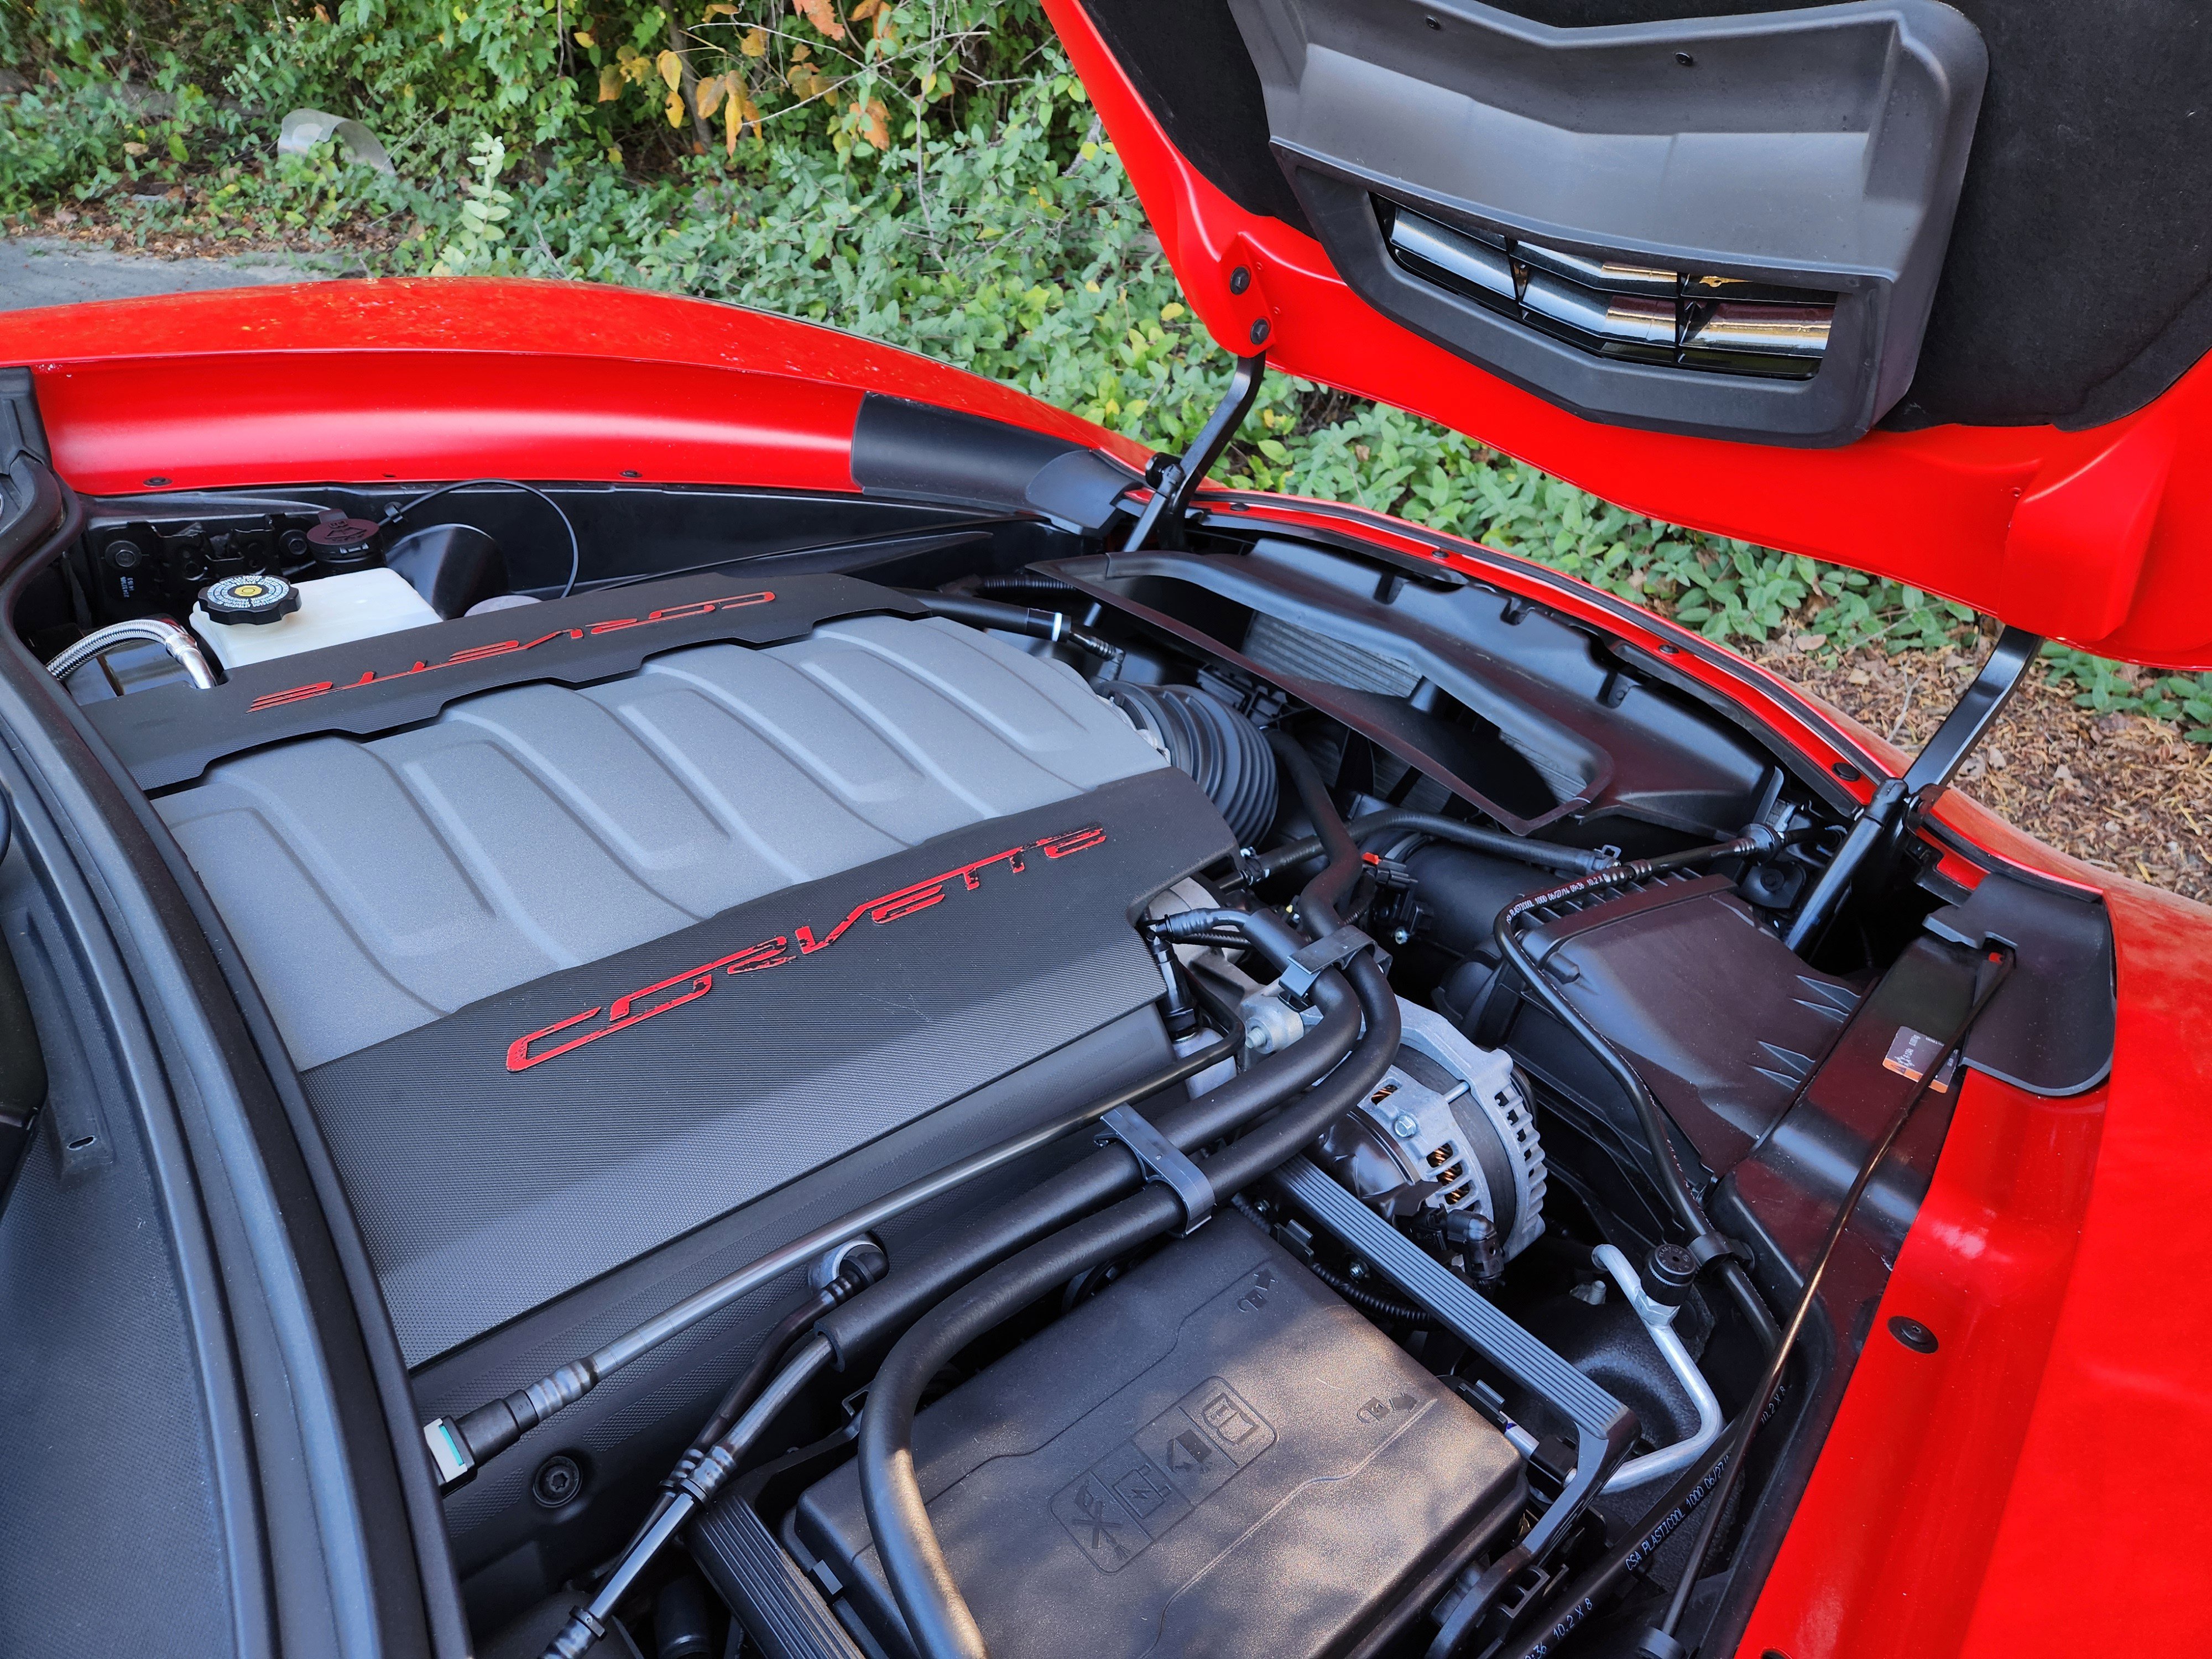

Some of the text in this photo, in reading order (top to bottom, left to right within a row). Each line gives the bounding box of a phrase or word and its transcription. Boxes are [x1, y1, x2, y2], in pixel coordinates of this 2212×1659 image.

[246, 591, 775, 713] CORVETTE
[1535, 895, 1548, 905] 1000
[1547, 887, 1570, 901] 06/27/14
[1569, 882, 1585, 893] 09:36
[1587, 877, 1599, 886] 10.2
[506, 827, 1106, 1071] CORVETTE
[1625, 1551, 1642, 1571] CSA
[1641, 1507, 1686, 1555] PLASTICOOL
[1686, 1486, 1704, 1509] 1000
[1553, 1615, 1575, 1640] 10.2
[1575, 1605, 1584, 1619] X
[1584, 1597, 1593, 1610] 8
